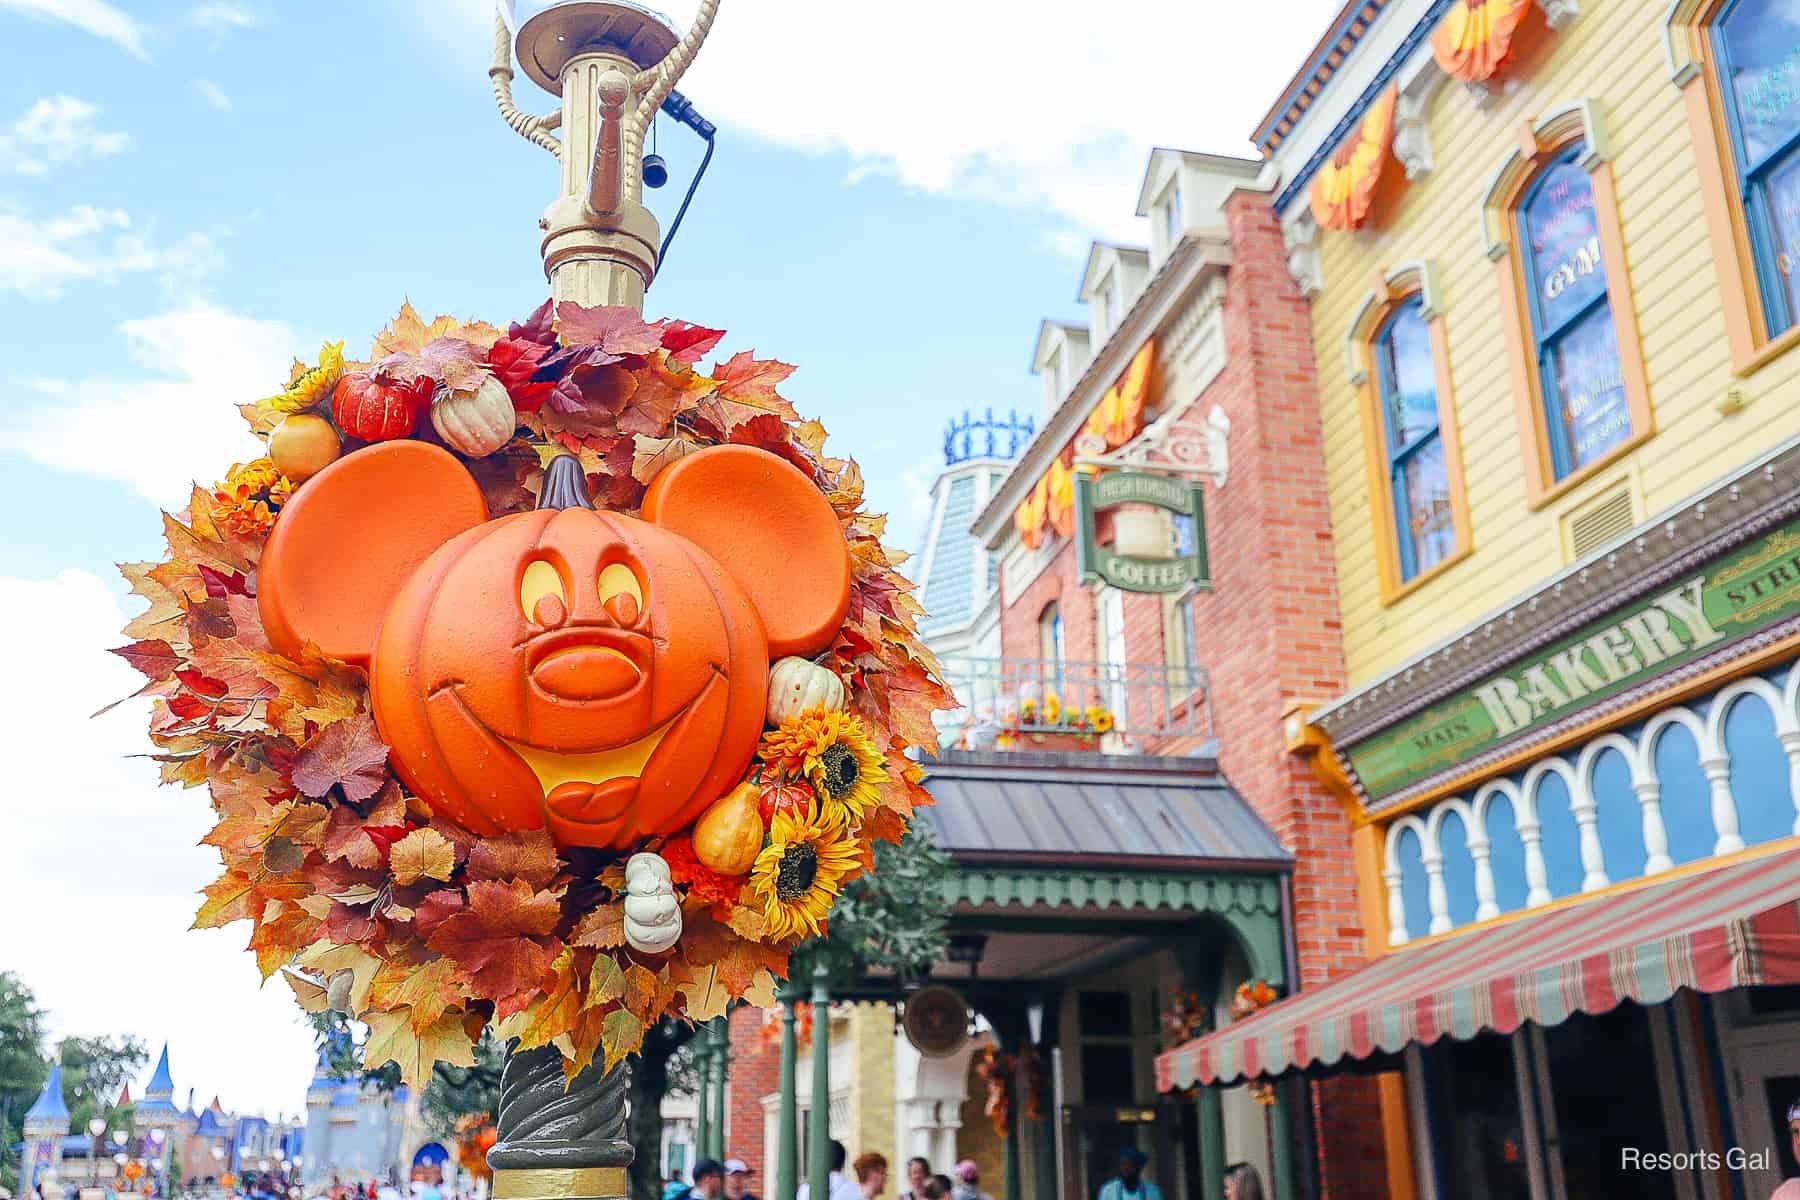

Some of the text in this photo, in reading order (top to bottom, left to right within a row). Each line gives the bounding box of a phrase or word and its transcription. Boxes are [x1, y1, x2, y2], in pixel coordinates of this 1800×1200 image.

[1543, 236, 1601, 300] GYM
[1106, 557, 1185, 586] COFFEE
[1412, 714, 1470, 752] MAIN
[1473, 575, 1726, 739] BAKERY
